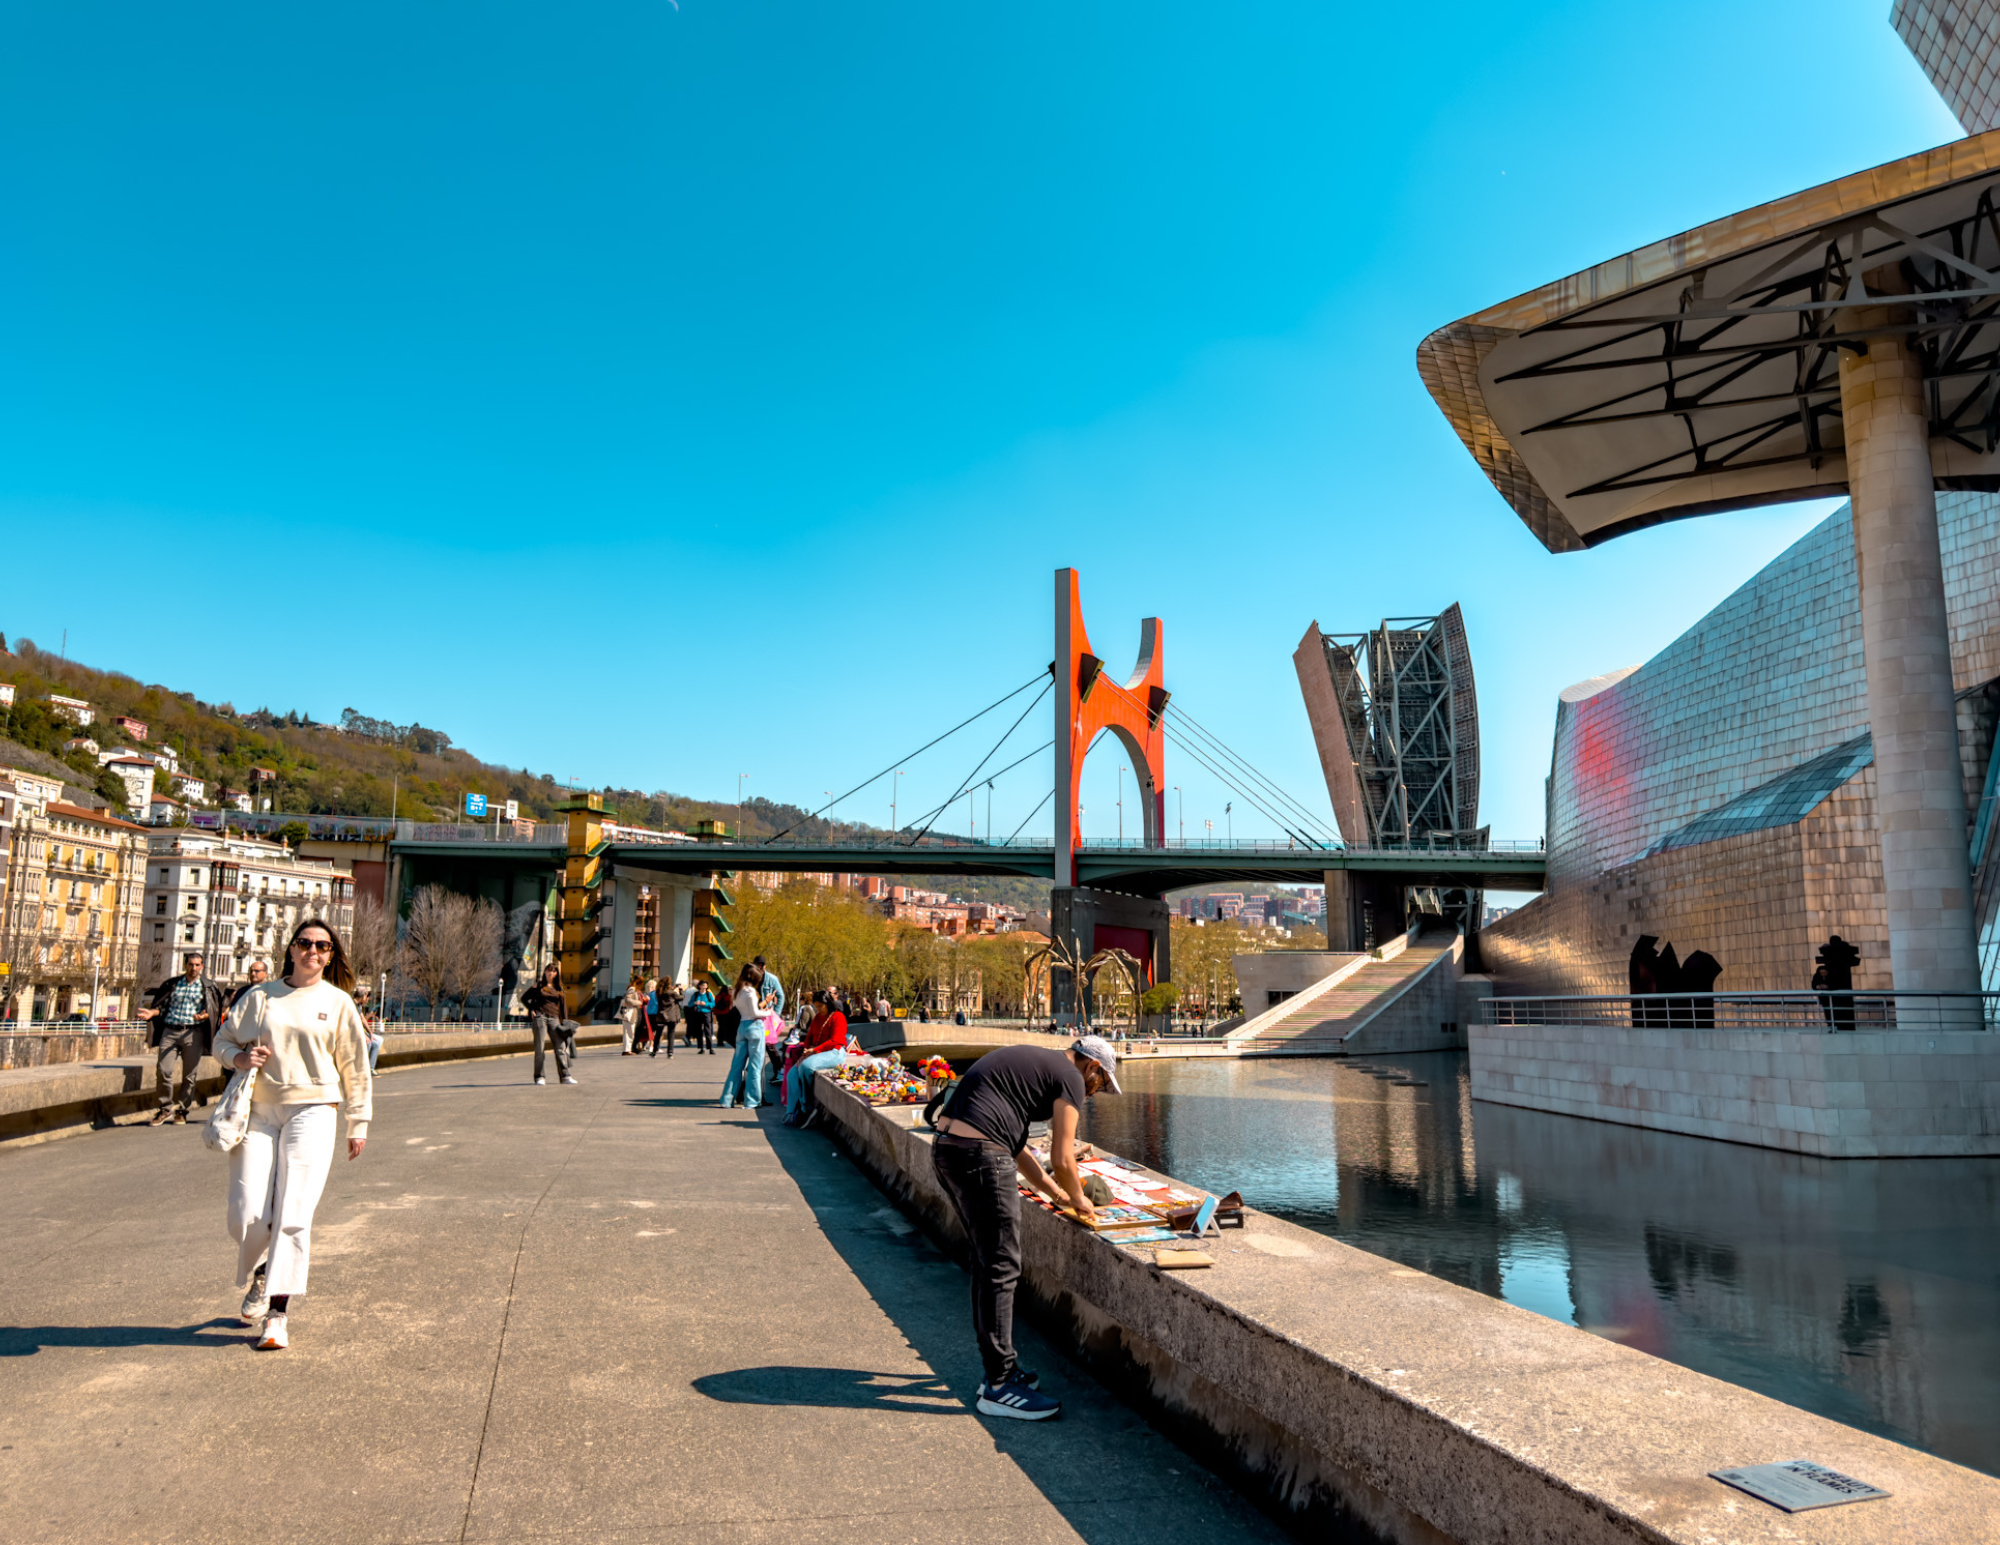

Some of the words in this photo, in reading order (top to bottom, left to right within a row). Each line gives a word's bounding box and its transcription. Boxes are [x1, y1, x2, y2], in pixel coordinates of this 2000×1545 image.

[1782, 1465, 1805, 1473] IN
[1800, 1472, 1858, 1493] FLAMES
[1822, 1471, 1881, 1493] BEAUTY
